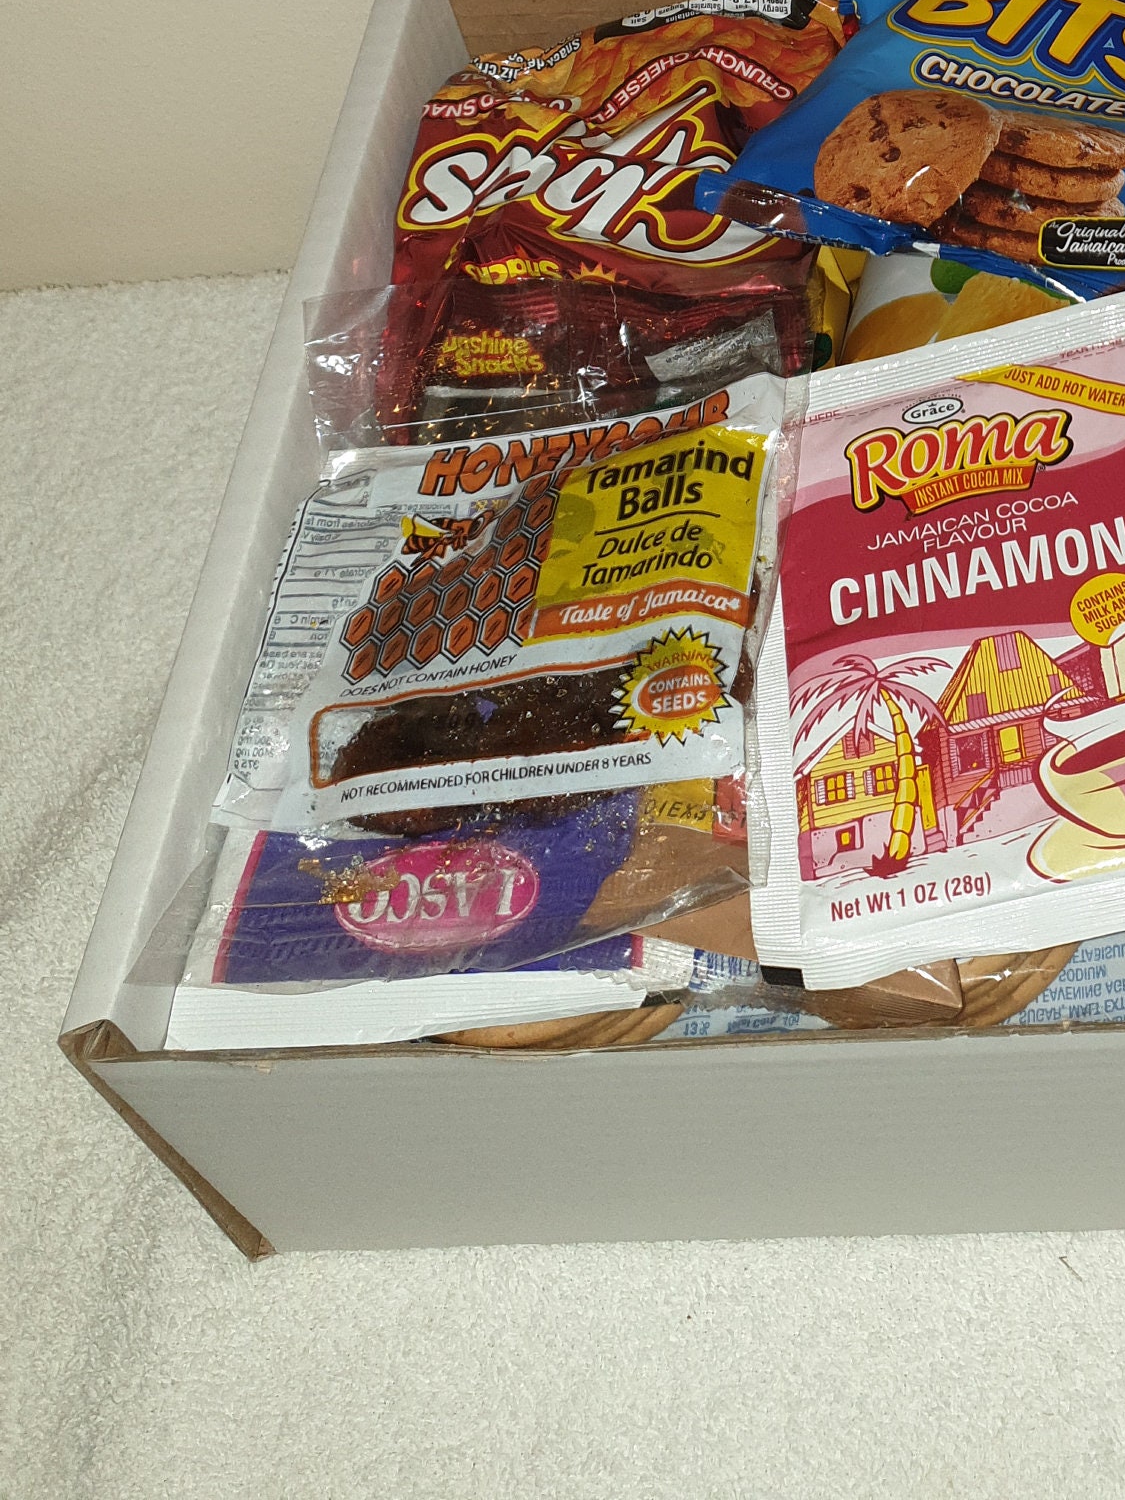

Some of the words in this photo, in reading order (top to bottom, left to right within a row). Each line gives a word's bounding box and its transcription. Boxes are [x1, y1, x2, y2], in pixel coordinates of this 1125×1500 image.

[631, 16, 647, 24] Salt
[762, 4, 788, 14] Energy
[613, 50, 690, 104] CHEESE
[695, 46, 792, 100] CRUNCHY
[1004, 367, 1033, 385] JUST
[1034, 374, 1061, 392] ADD
[1062, 380, 1088, 397] HOT
[910, 403, 955, 419] Grace
[419, 389, 731, 496] HONEYCOMB
[848, 412, 1069, 508] Roma
[586, 441, 755, 494] Tamarind
[914, 477, 960, 508] INSTANT
[961, 472, 1001, 498] COCOA
[1003, 469, 1024, 488] MIX
[617, 476, 703, 521] Balls
[597, 530, 666, 560] Dulce
[670, 519, 703, 542] de
[867, 509, 990, 551] JAMAICAN
[996, 491, 1079, 519] COCOA
[922, 517, 1027, 554] FLAVOUR
[581, 545, 713, 588] Tamarindo
[559, 604, 611, 627] Taste
[615, 600, 635, 623] of
[639, 590, 728, 618] Jamaica
[1083, 604, 1109, 624] MILK
[339, 684, 378, 697] DOES
[378, 676, 408, 693] NOT
[405, 666, 469, 684] CONTAIN
[469, 654, 518, 675] HONEY
[647, 650, 715, 671] WARNING
[649, 674, 711, 694] CONTAINS
[652, 691, 707, 714] SEEDS
[340, 786, 365, 803] NOT
[366, 774, 463, 796] RECOMMENDED
[465, 771, 490, 789] FOR
[492, 763, 553, 782] CHILDREN
[556, 758, 600, 775] UNDER
[602, 757, 610, 770] 8
[612, 752, 652, 769] YEARS
[347, 867, 516, 924] LASCO
[831, 899, 862, 921] Net
[866, 891, 894, 913] Wt
[896, 890, 904, 907] 1
[914, 883, 938, 904] OZ
[944, 871, 992, 903] (28g)
